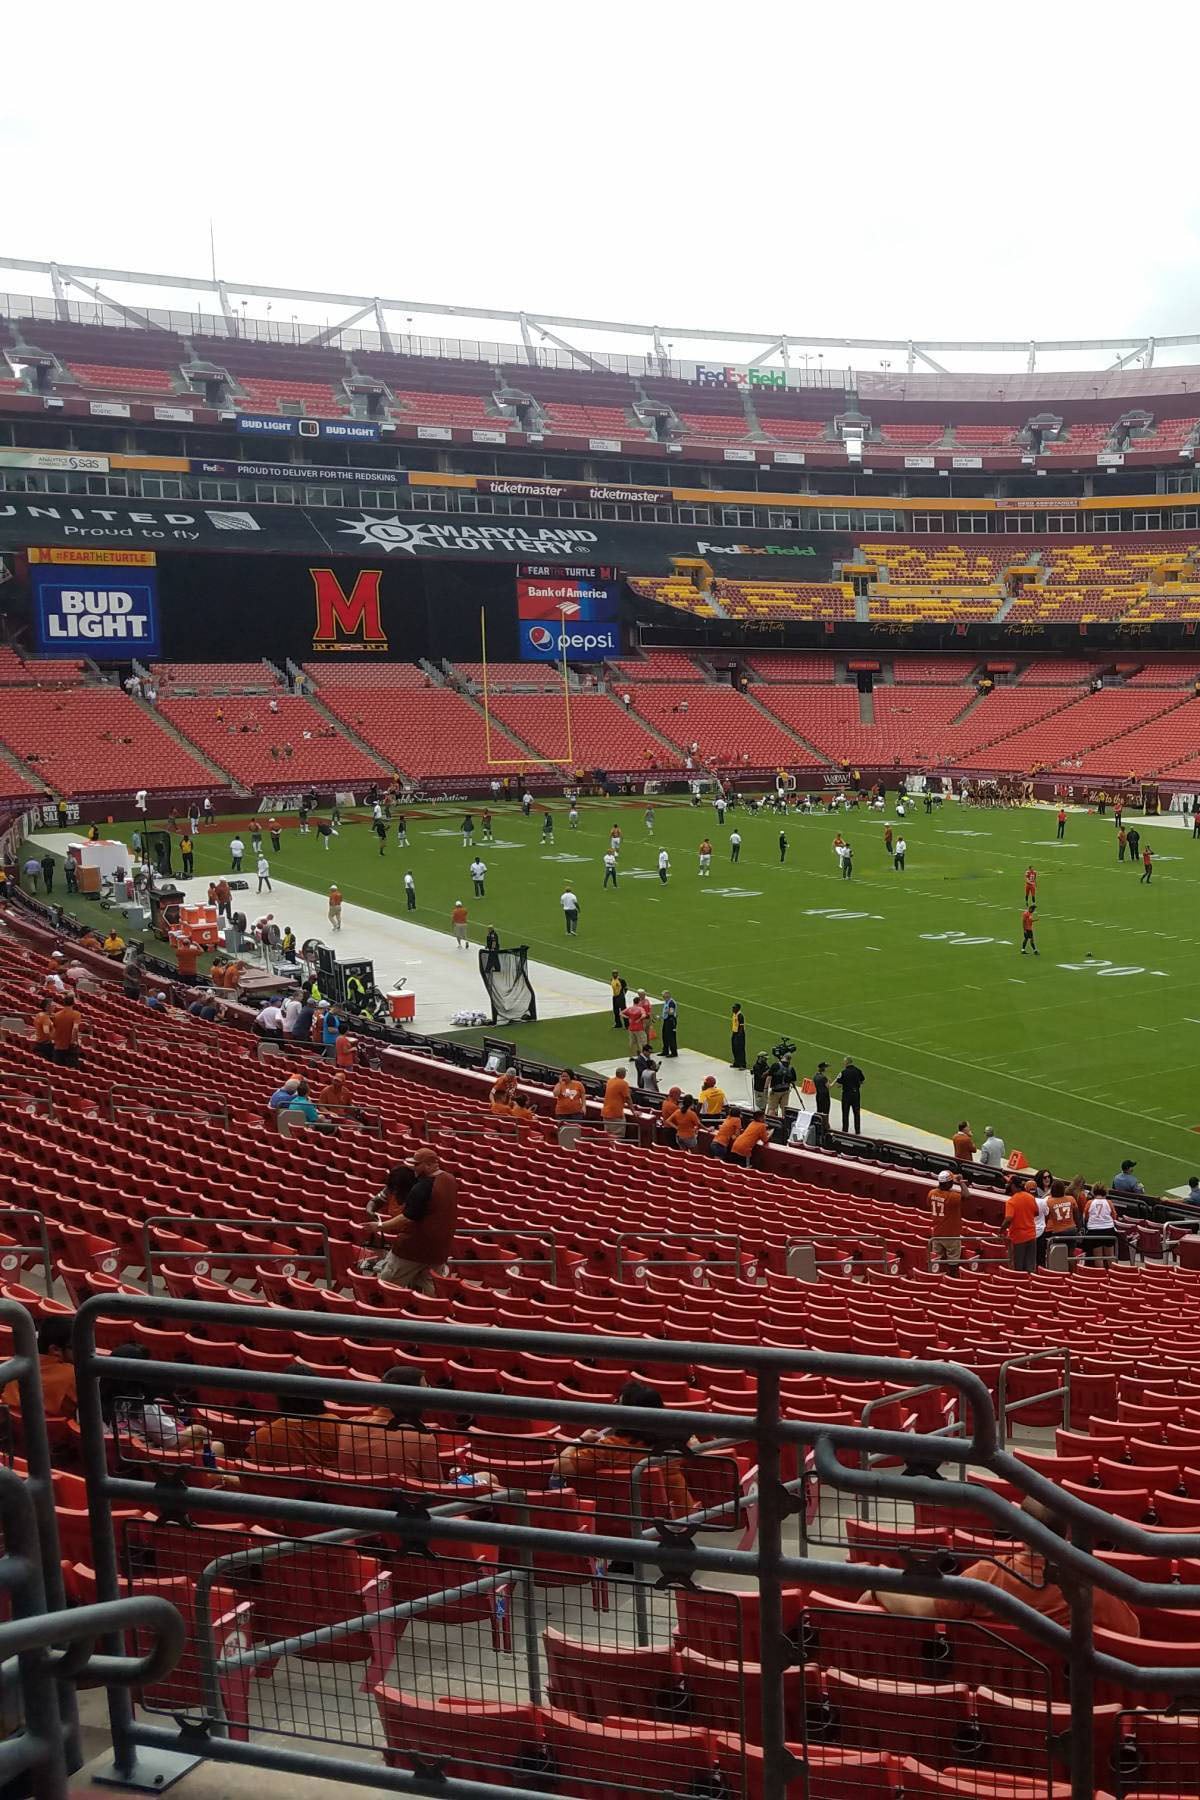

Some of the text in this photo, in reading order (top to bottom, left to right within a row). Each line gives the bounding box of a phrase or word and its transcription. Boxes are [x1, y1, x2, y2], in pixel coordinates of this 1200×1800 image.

[696, 365, 787, 386] FedExField
[242, 420, 292, 431] BUD LIGHT
[326, 426, 374, 437] BUD LIGHT
[79, 458, 99, 469] sas
[238, 466, 398, 482] PROUD TO DELIVER FOR THE REDSKINS.
[490, 481, 562, 497] ticketmaster
[590, 487, 659, 502] ticketmaster
[0, 506, 196, 525] UNITED
[64, 526, 200, 541] Proud to fly
[428, 524, 599, 543] MARYLAND
[437, 536, 574, 554] LOTTERY
[697, 541, 817, 556] FedExField
[528, 586, 607, 599] Bank of America
[61, 591, 133, 614] BUD
[309, 567, 388, 641] M
[48, 614, 147, 637] LIGHT
[558, 632, 612, 652] pepsi
[43, 804, 79, 812] REDINS
[920, 931, 993, 945] 30
[1056, 960, 1145, 976] 20
[930, 1201, 945, 1217] 17
[1054, 1206, 1072, 1221] 17
